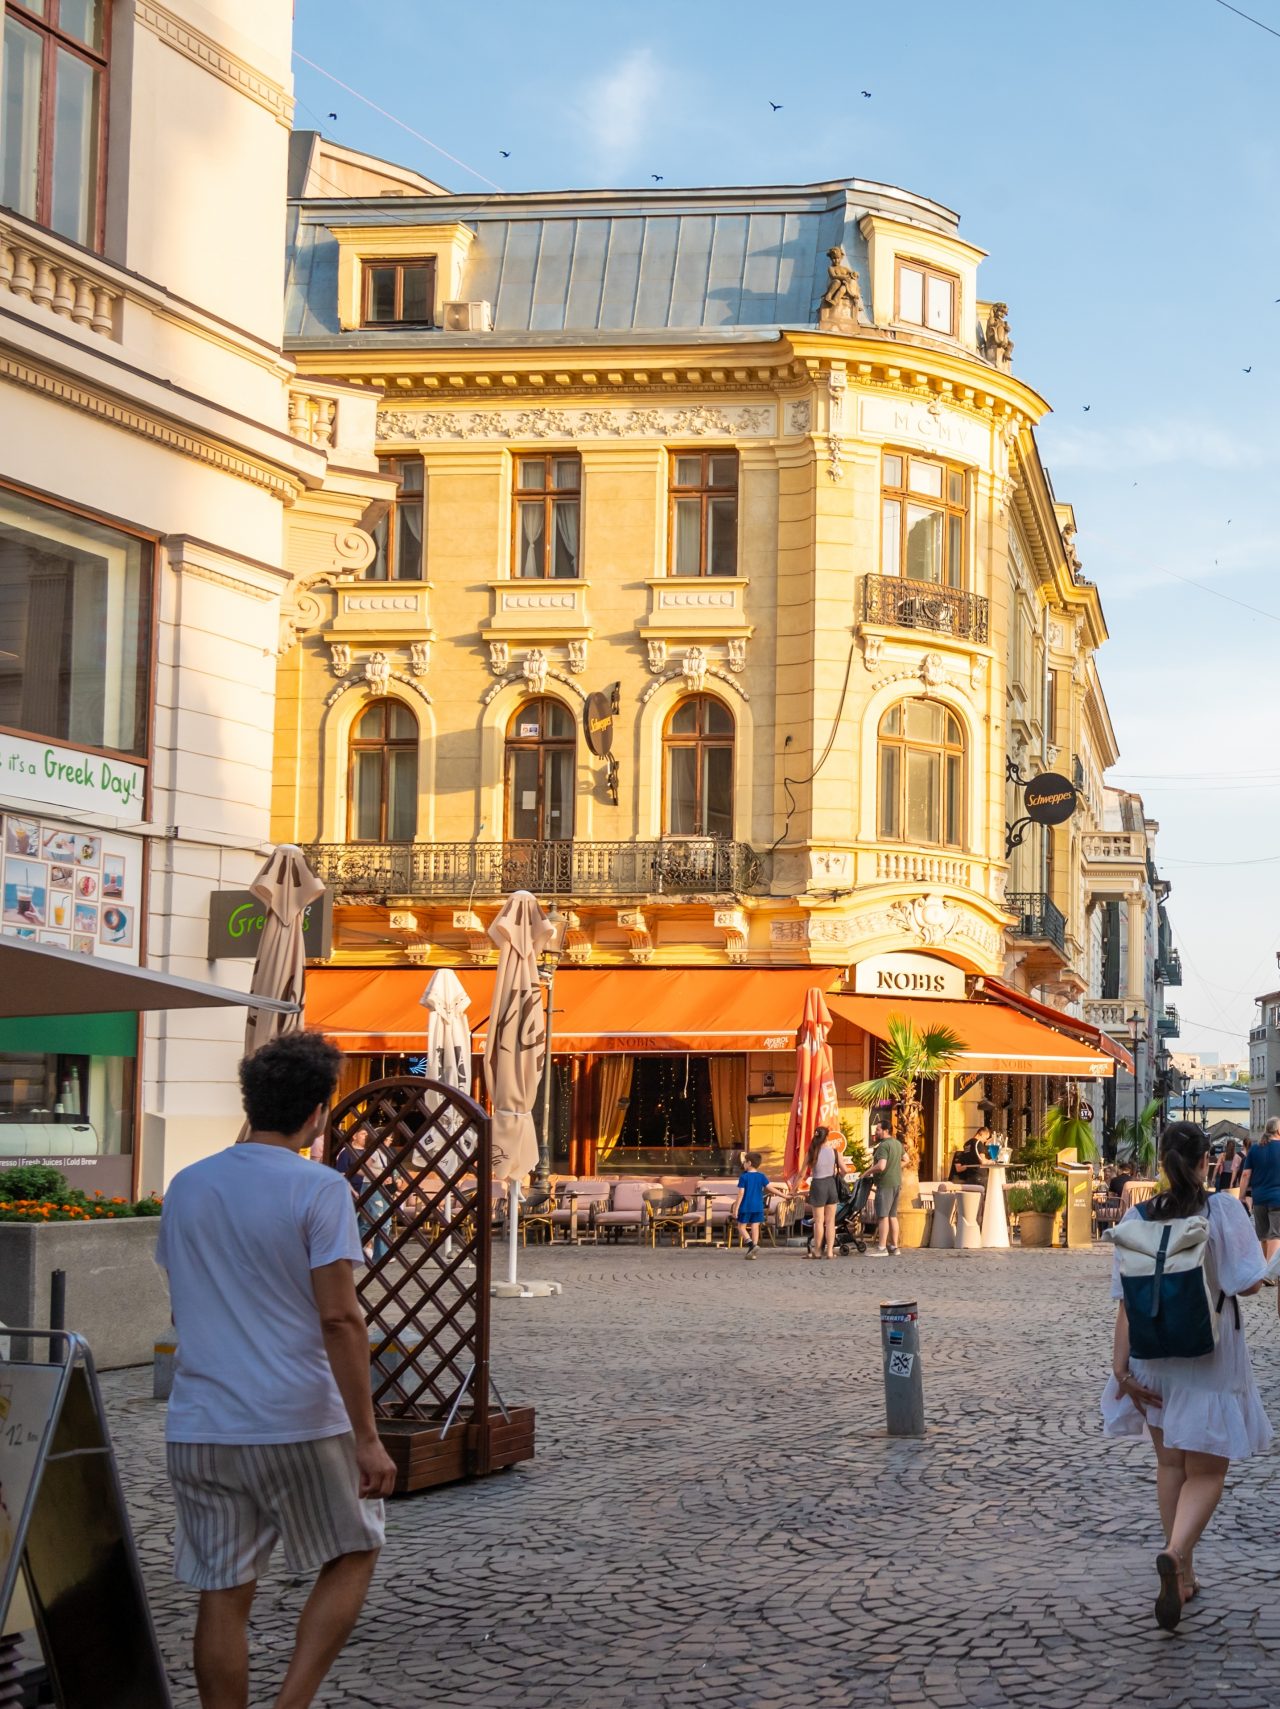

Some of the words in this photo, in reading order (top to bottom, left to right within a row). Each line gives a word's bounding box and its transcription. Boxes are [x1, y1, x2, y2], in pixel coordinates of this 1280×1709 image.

[29, 764, 36, 775] a
[44, 749, 94, 787] Greek
[101, 763, 136, 804] Day!
[1027, 791, 1073, 807] Schweppes
[876, 971, 945, 993] NOBIS
[617, 1038, 656, 1048] NOBIS
[1001, 1059, 1033, 1070] NOBIS
[42, 1158, 62, 1166] Juices
[66, 1158, 80, 1166] Cold
[81, 1158, 97, 1166] Brew
